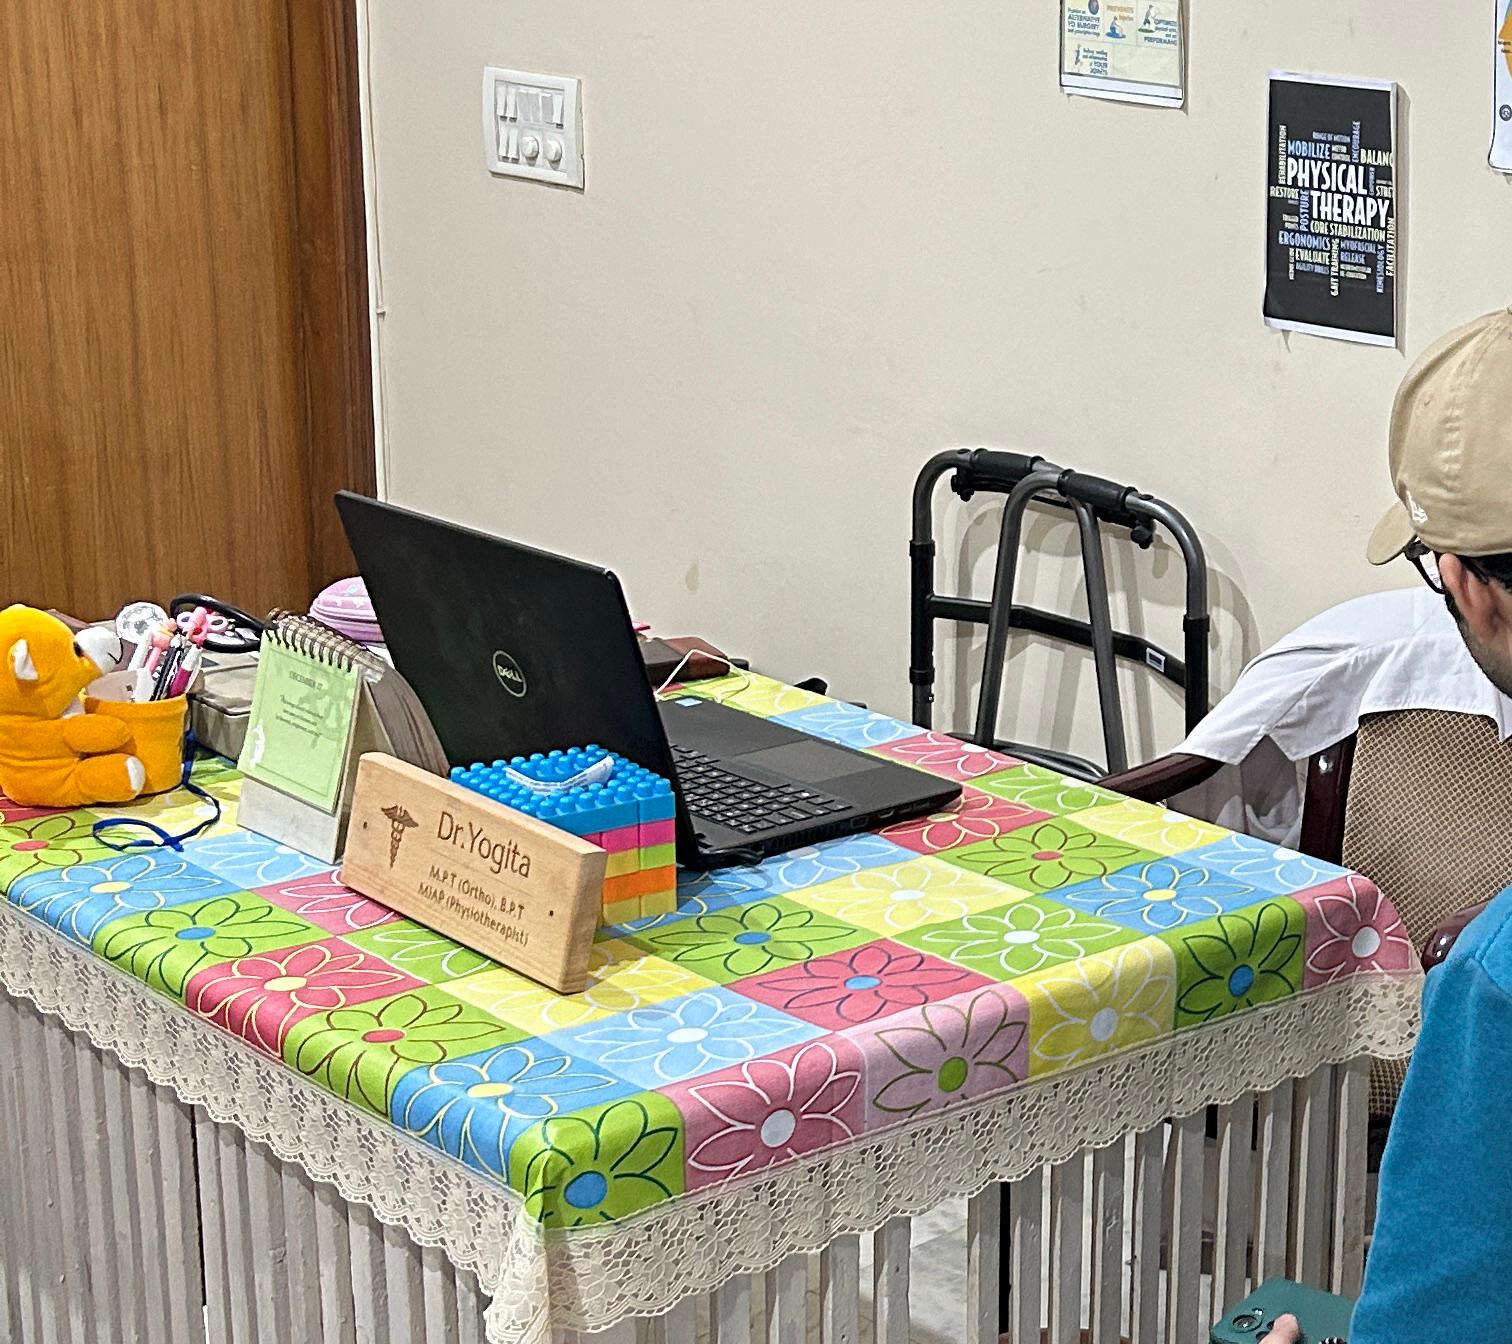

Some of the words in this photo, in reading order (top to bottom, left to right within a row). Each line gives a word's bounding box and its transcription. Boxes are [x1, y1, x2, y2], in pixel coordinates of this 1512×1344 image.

[1287, 139, 1330, 160] MOBILIZE
[1287, 157, 1368, 195] PHYSICAL
[1269, 186, 1299, 199] RESTORE
[1300, 188, 1310, 232] POSTURE
[1310, 190, 1390, 228] THERAPY
[1278, 230, 1331, 251] ERGONOMICS
[1310, 219, 1329, 235] CORE
[1330, 221, 1386, 242] STABILIZATION
[1295, 247, 1330, 265] EVALUATE
[1386, 216, 1396, 276] FACILITATION
[1340, 251, 1366, 264] RELEASE
[497, 664, 523, 683] DELL
[417, 882, 445, 905] MIAP
[446, 895, 529, 947] (Physiotherapist)
